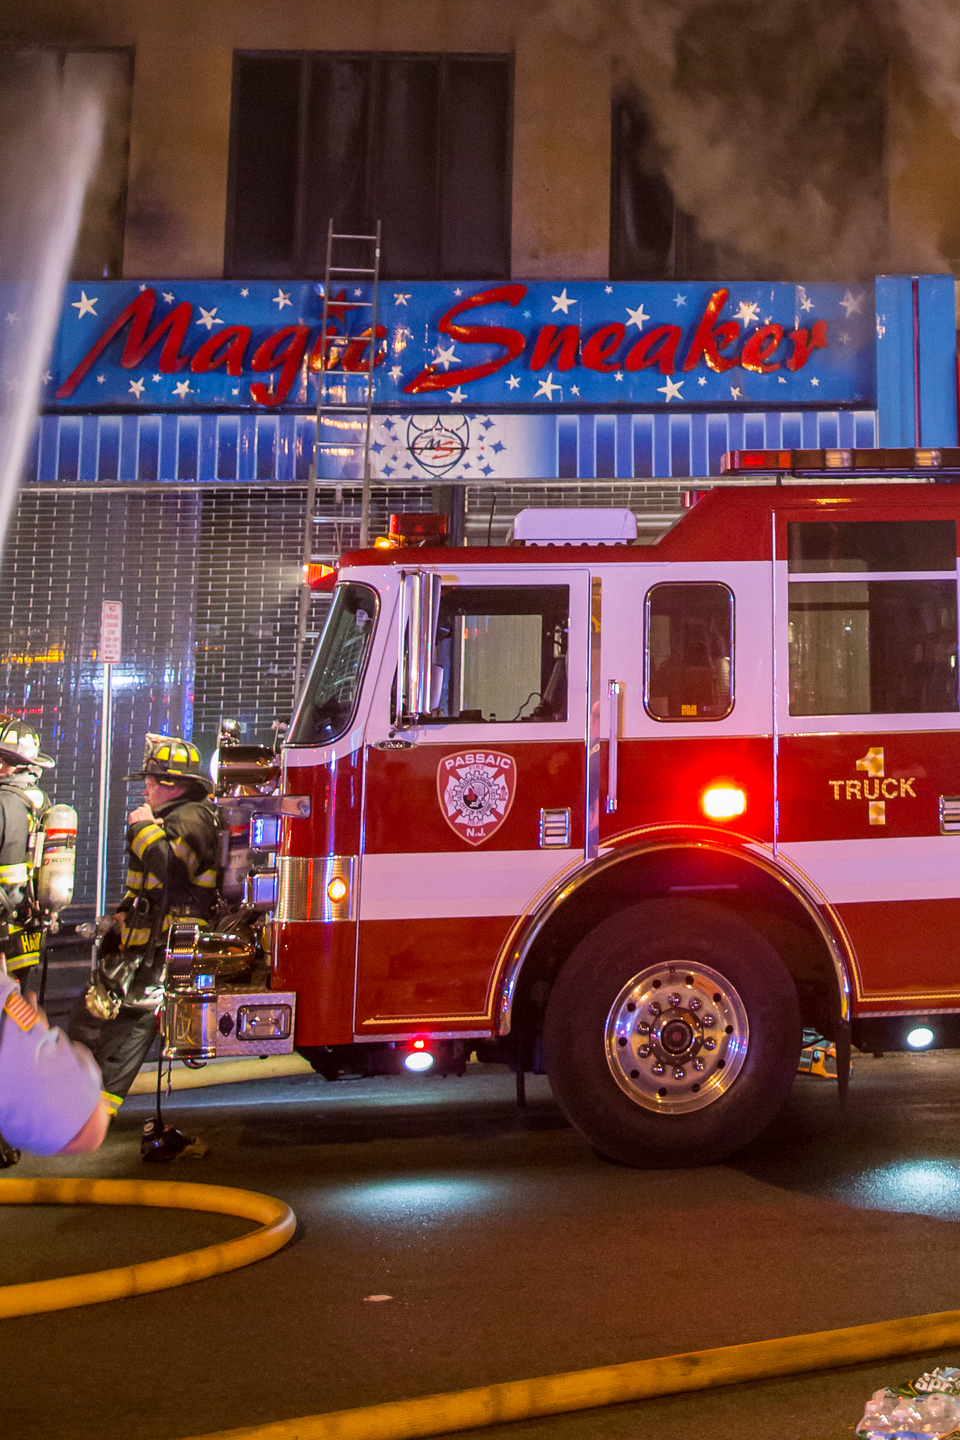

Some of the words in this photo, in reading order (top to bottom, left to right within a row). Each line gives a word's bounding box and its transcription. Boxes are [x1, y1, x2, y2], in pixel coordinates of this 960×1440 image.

[56, 288, 387, 406] Magic
[403, 284, 828, 394] Sneaker
[444, 753, 512, 771] PASSAIC
[828, 777, 917, 800] TRUCK
[466, 827, 486, 837] N.J.
